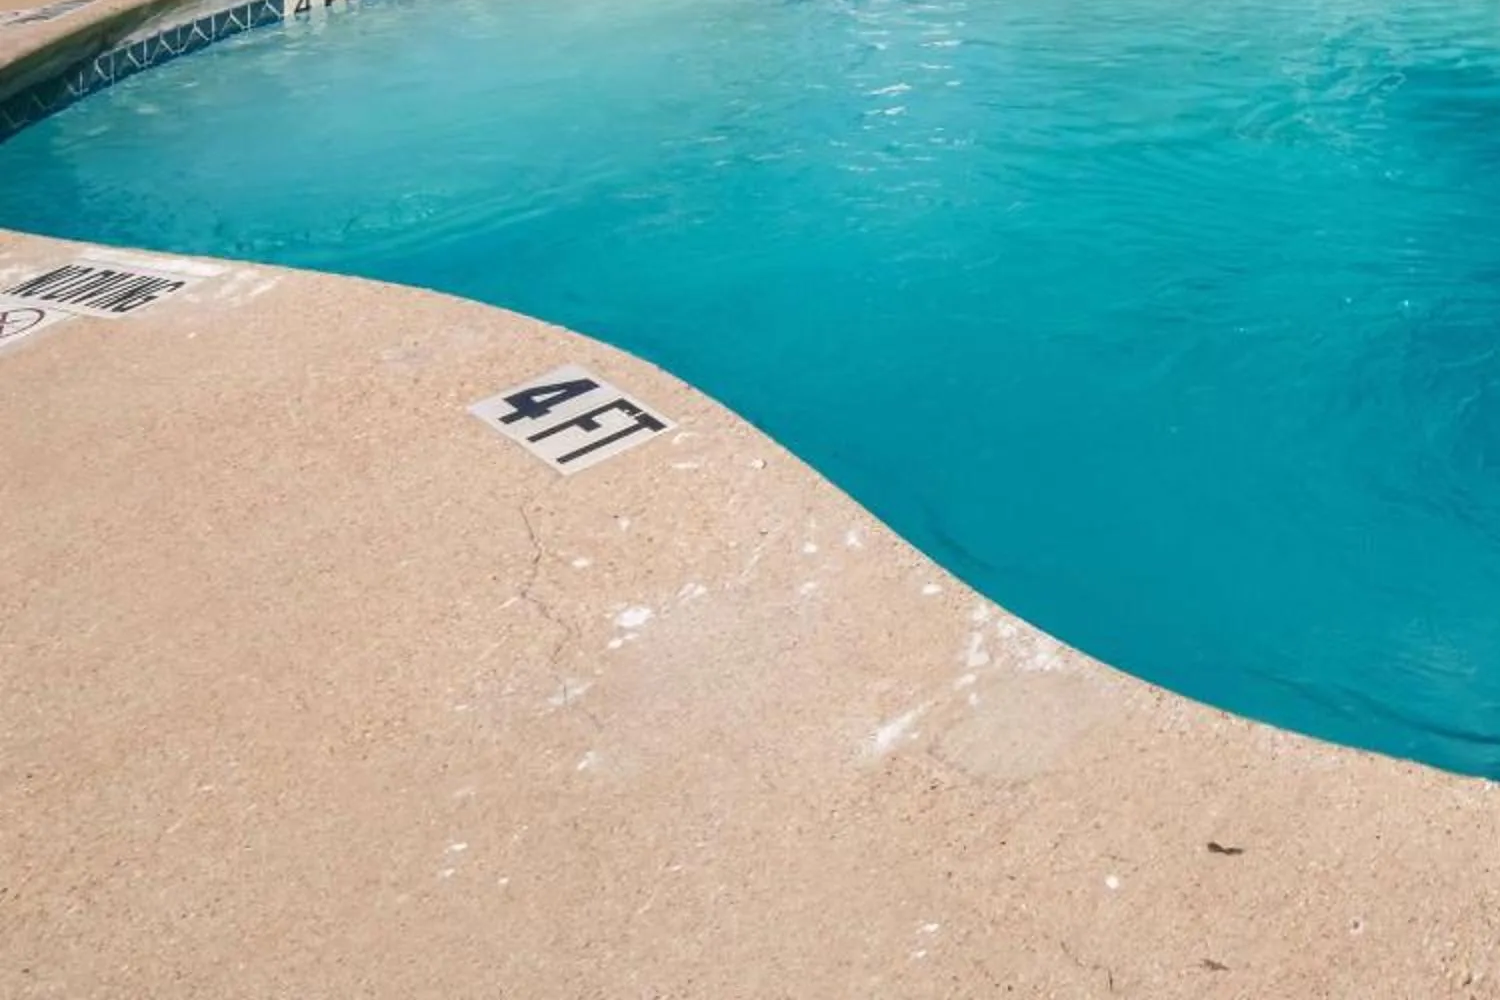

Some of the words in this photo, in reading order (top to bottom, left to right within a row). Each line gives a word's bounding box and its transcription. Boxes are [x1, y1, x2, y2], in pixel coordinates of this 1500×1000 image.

[0, 264, 96, 298] NO
[40, 268, 187, 313] DIVING
[498, 378, 600, 424] 4
[526, 398, 667, 464] FT
